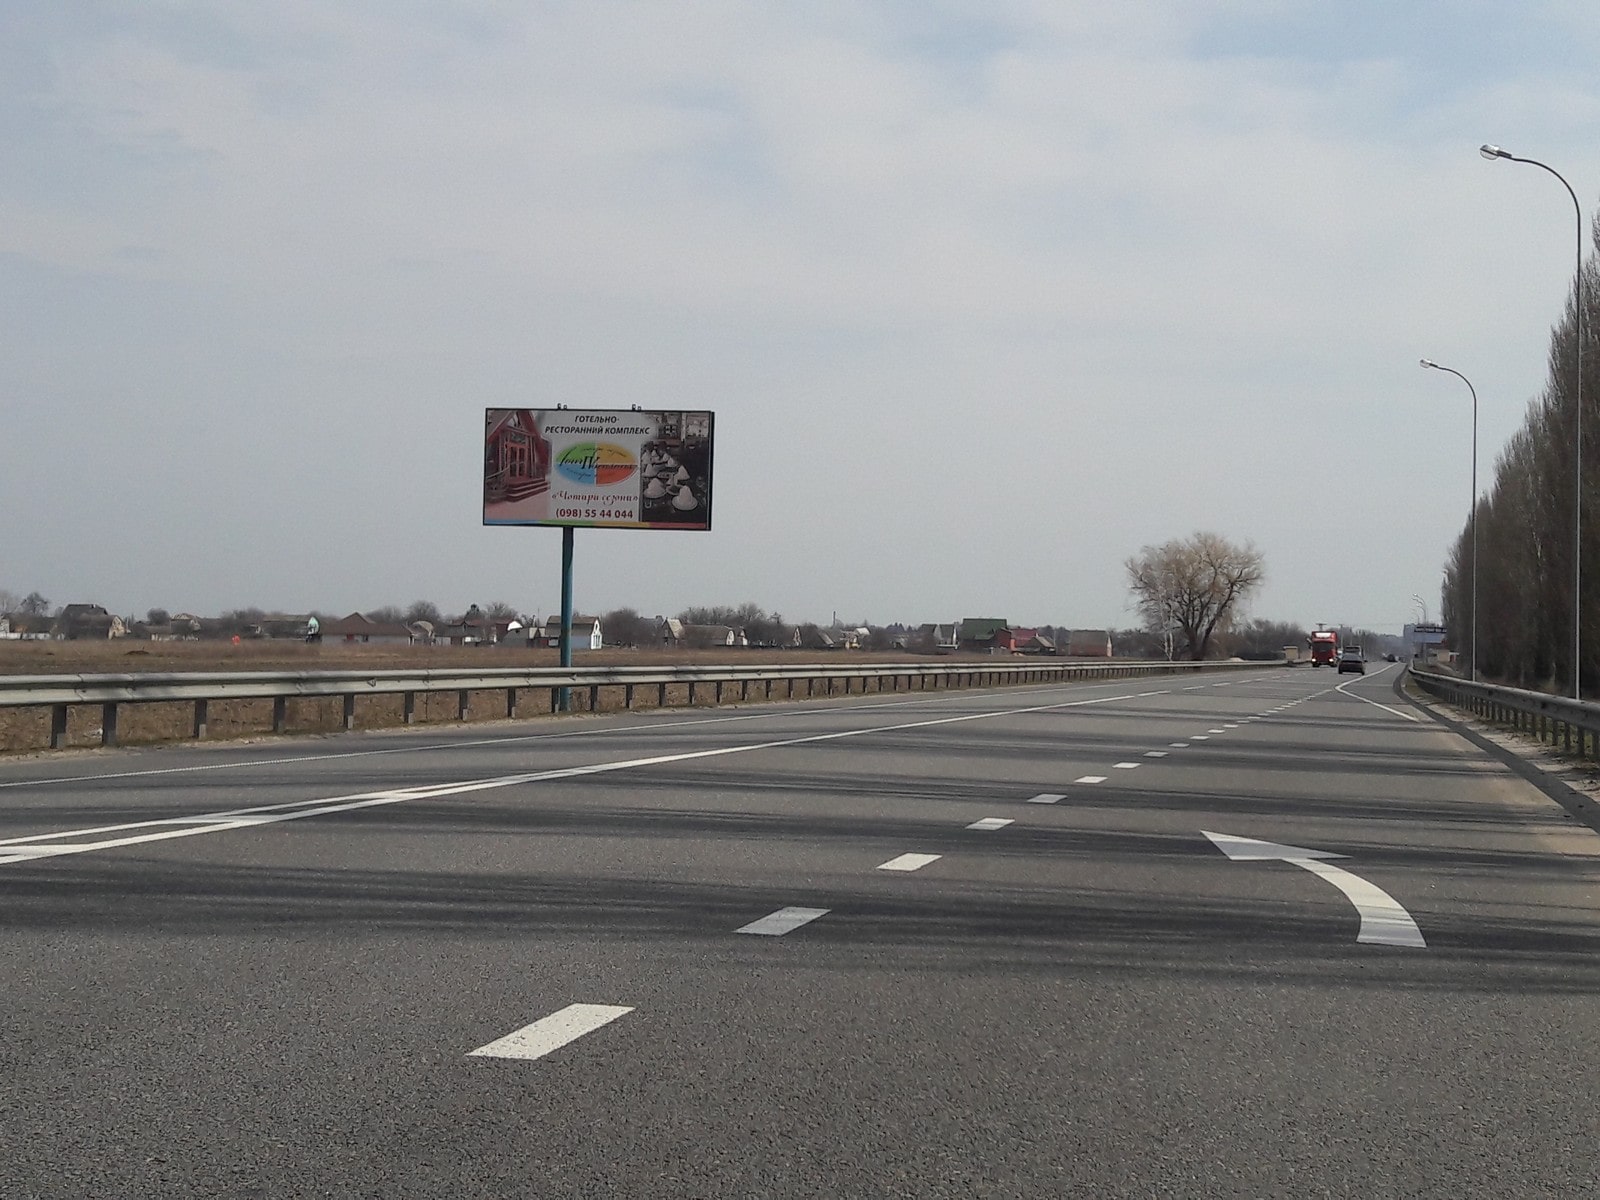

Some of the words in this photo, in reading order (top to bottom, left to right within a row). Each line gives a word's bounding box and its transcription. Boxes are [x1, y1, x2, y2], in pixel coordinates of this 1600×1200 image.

[544, 425, 604, 434] РЕСТОРАННИЙ
[604, 427, 651, 435] КОМПЛЕКС
[555, 508, 582, 518] (098)
[584, 509, 597, 518] 55
[599, 509, 612, 518] 44
[614, 510, 634, 519] 044
